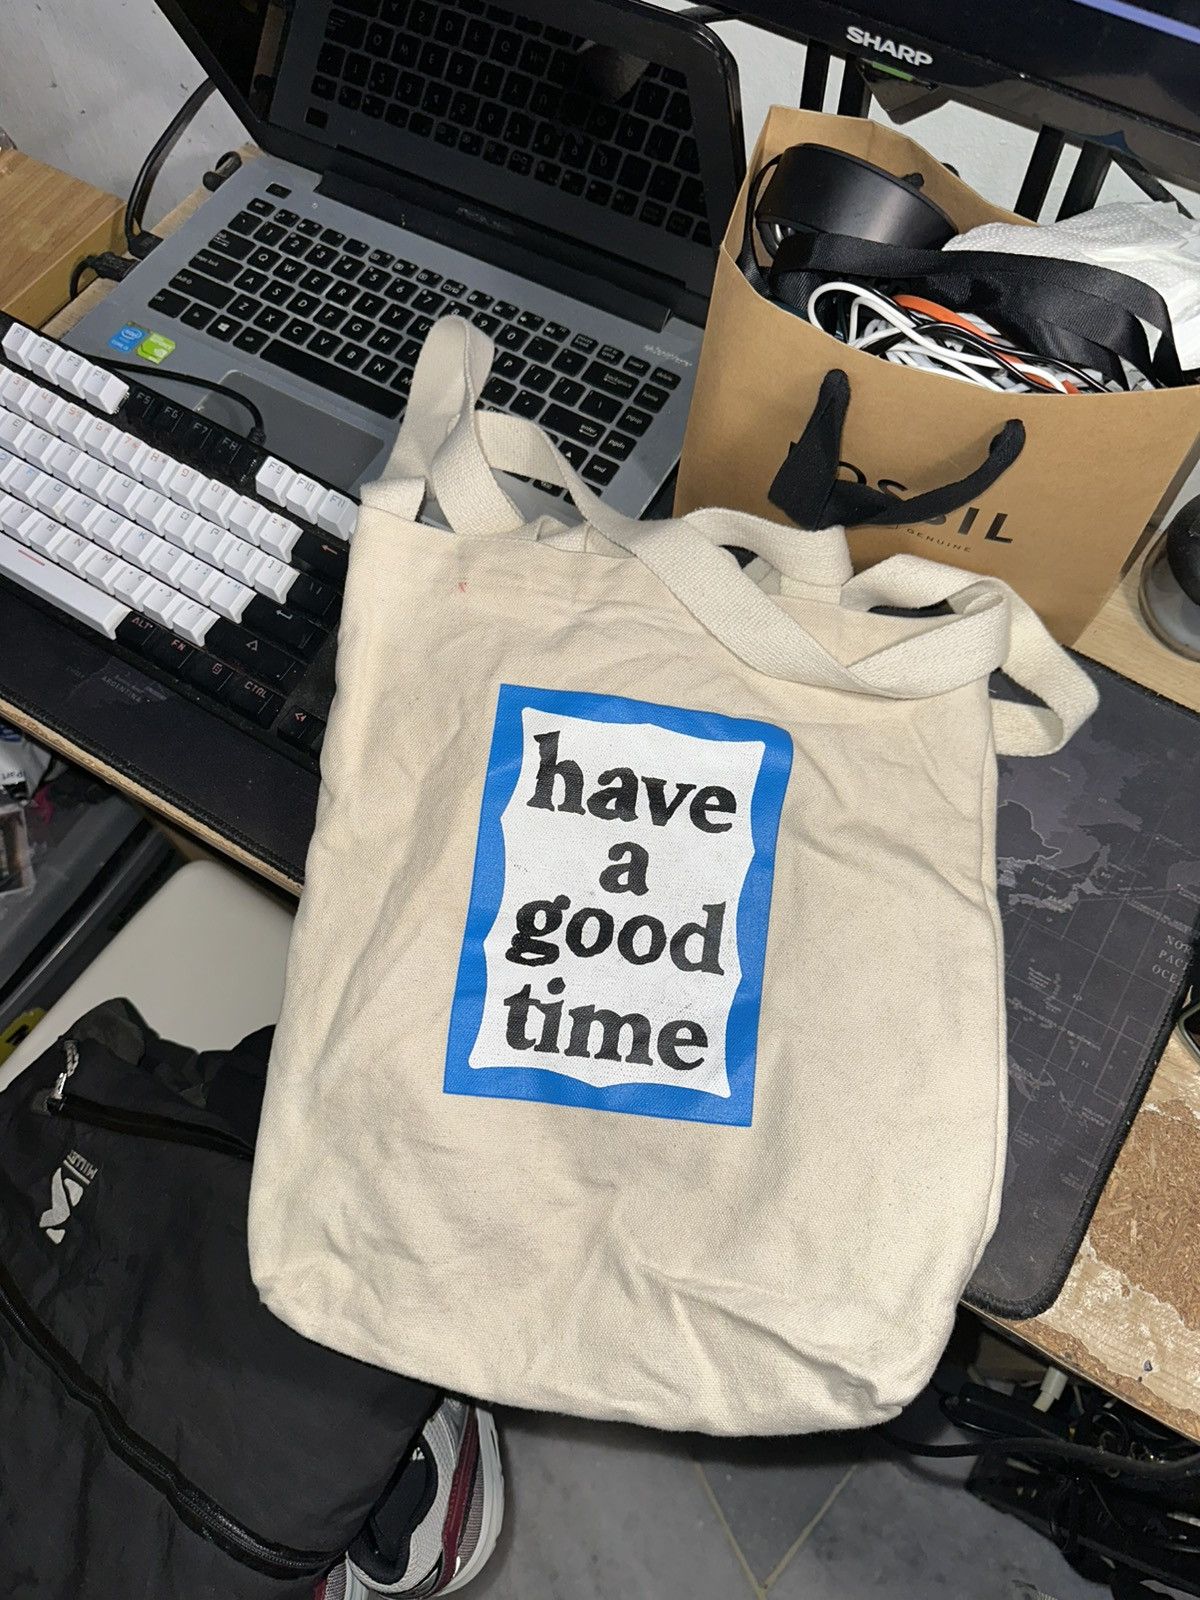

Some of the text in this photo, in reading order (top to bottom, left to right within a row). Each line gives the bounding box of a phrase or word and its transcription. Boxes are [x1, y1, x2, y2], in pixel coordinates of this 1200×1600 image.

[846, 26, 933, 66] SHARP
[906, 528, 972, 553] GENUINE
[171, 639, 186, 651] FN
[243, 681, 268, 699] CTRL
[526, 730, 737, 833] have
[599, 842, 649, 896] a
[505, 895, 727, 976] good
[504, 977, 708, 1071] time
